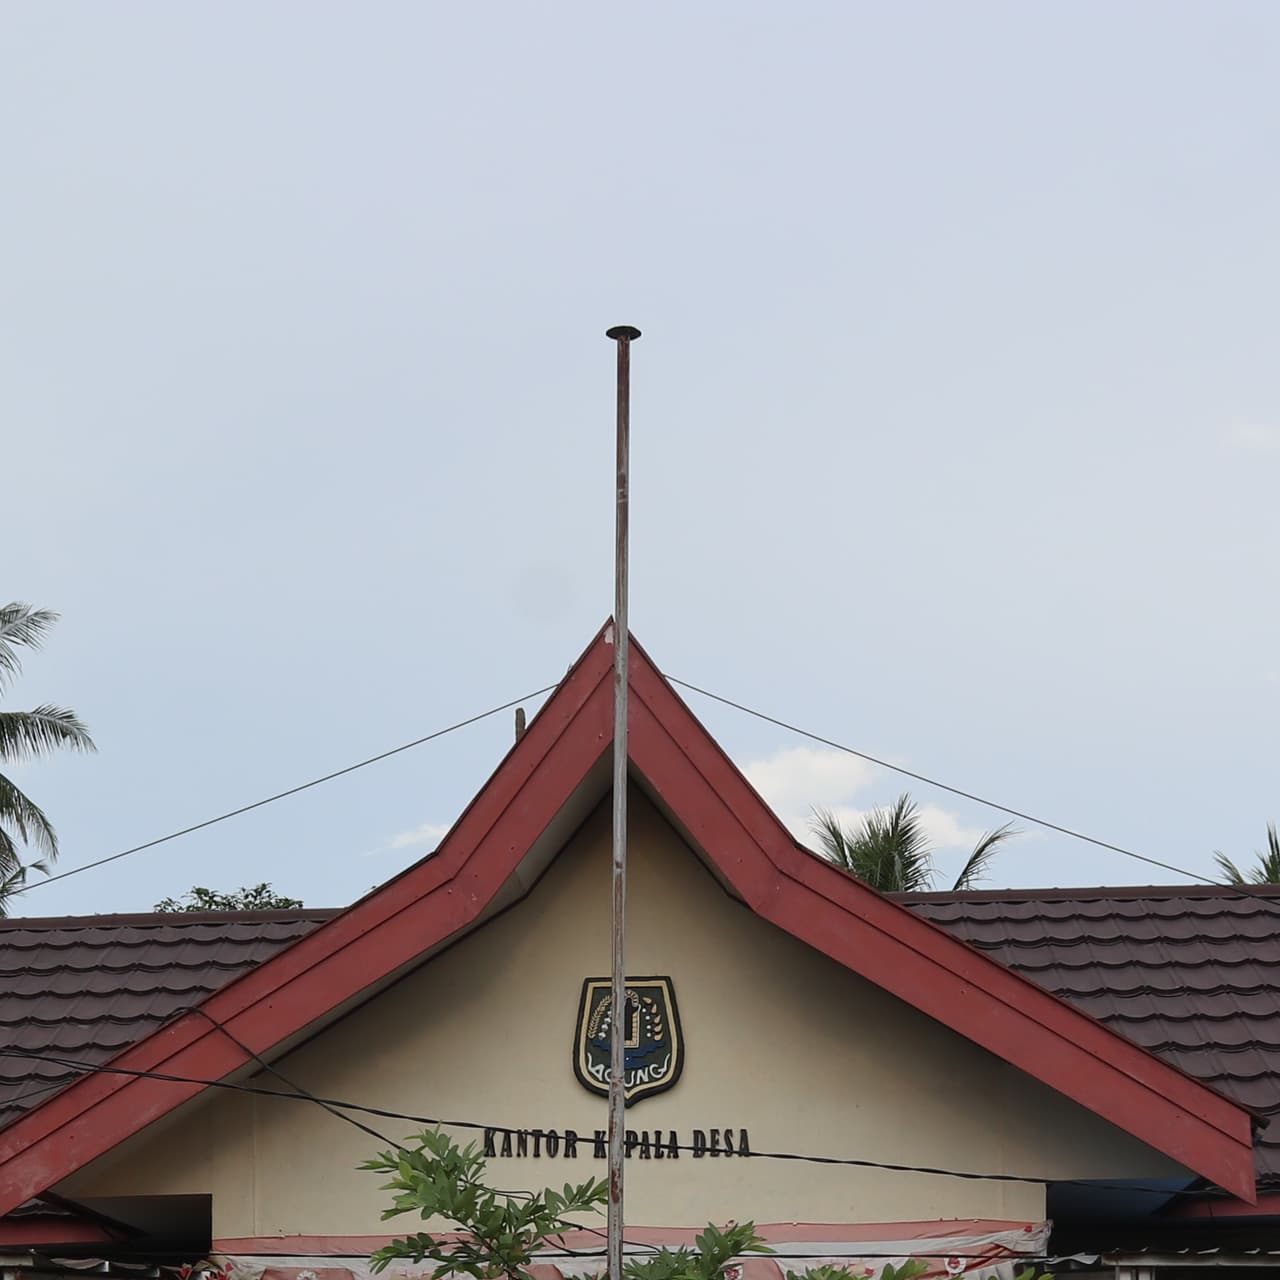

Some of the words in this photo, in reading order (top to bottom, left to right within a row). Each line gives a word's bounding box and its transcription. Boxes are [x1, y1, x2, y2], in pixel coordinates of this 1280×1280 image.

[483, 1129, 578, 1159] KANTOR
[593, 1130, 680, 1160] KPALA
[692, 1128, 751, 1159] DESA
